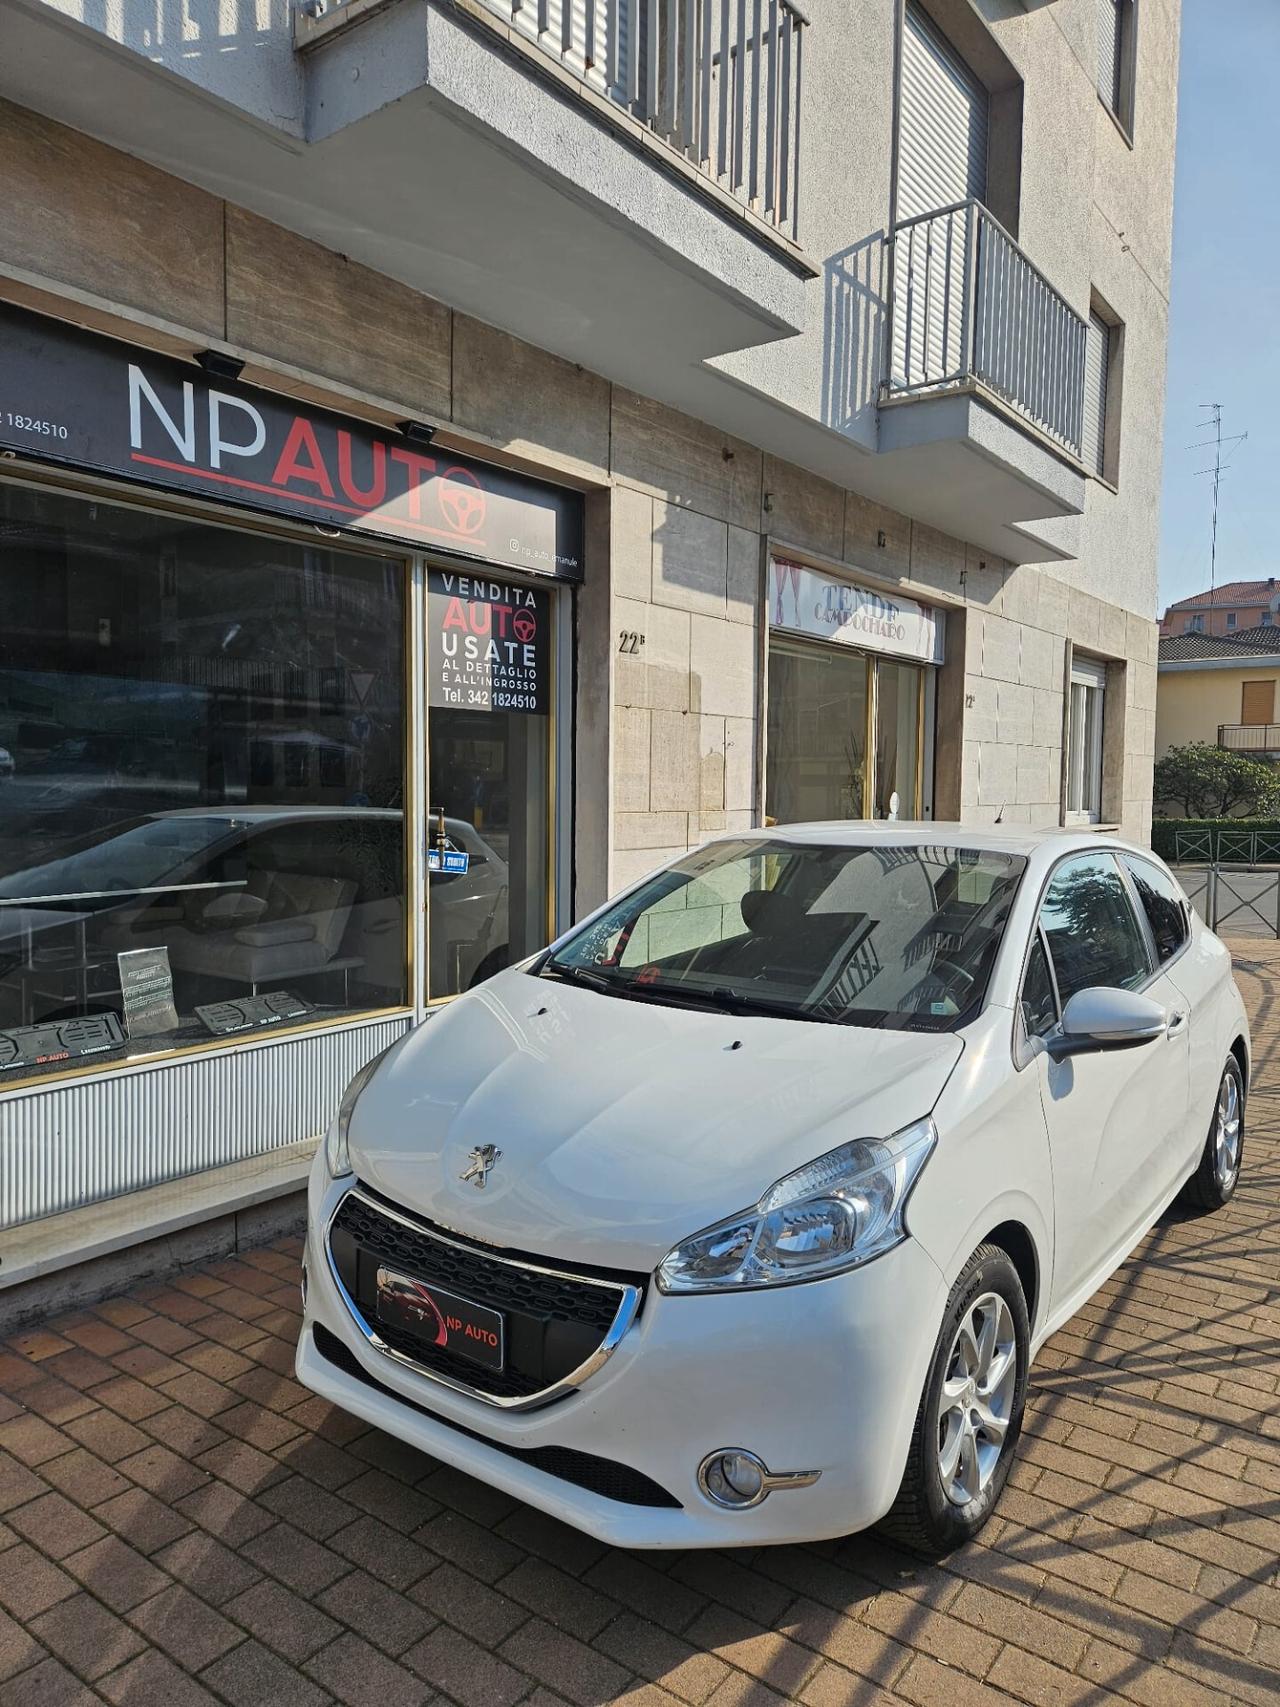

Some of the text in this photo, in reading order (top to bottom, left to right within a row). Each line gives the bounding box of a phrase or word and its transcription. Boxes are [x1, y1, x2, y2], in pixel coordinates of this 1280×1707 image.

[7, 413, 68, 439] 1824510
[128, 363, 266, 469] NP
[441, 573, 536, 608] VENDITA
[442, 632, 536, 667] USATE
[443, 658, 537, 679] AL DETTAGLIO
[443, 672, 537, 691] E ALL'INGROSSO
[443, 687, 537, 709] Tel. 342 1824510
[446, 1315, 498, 1347] NP AUTO
